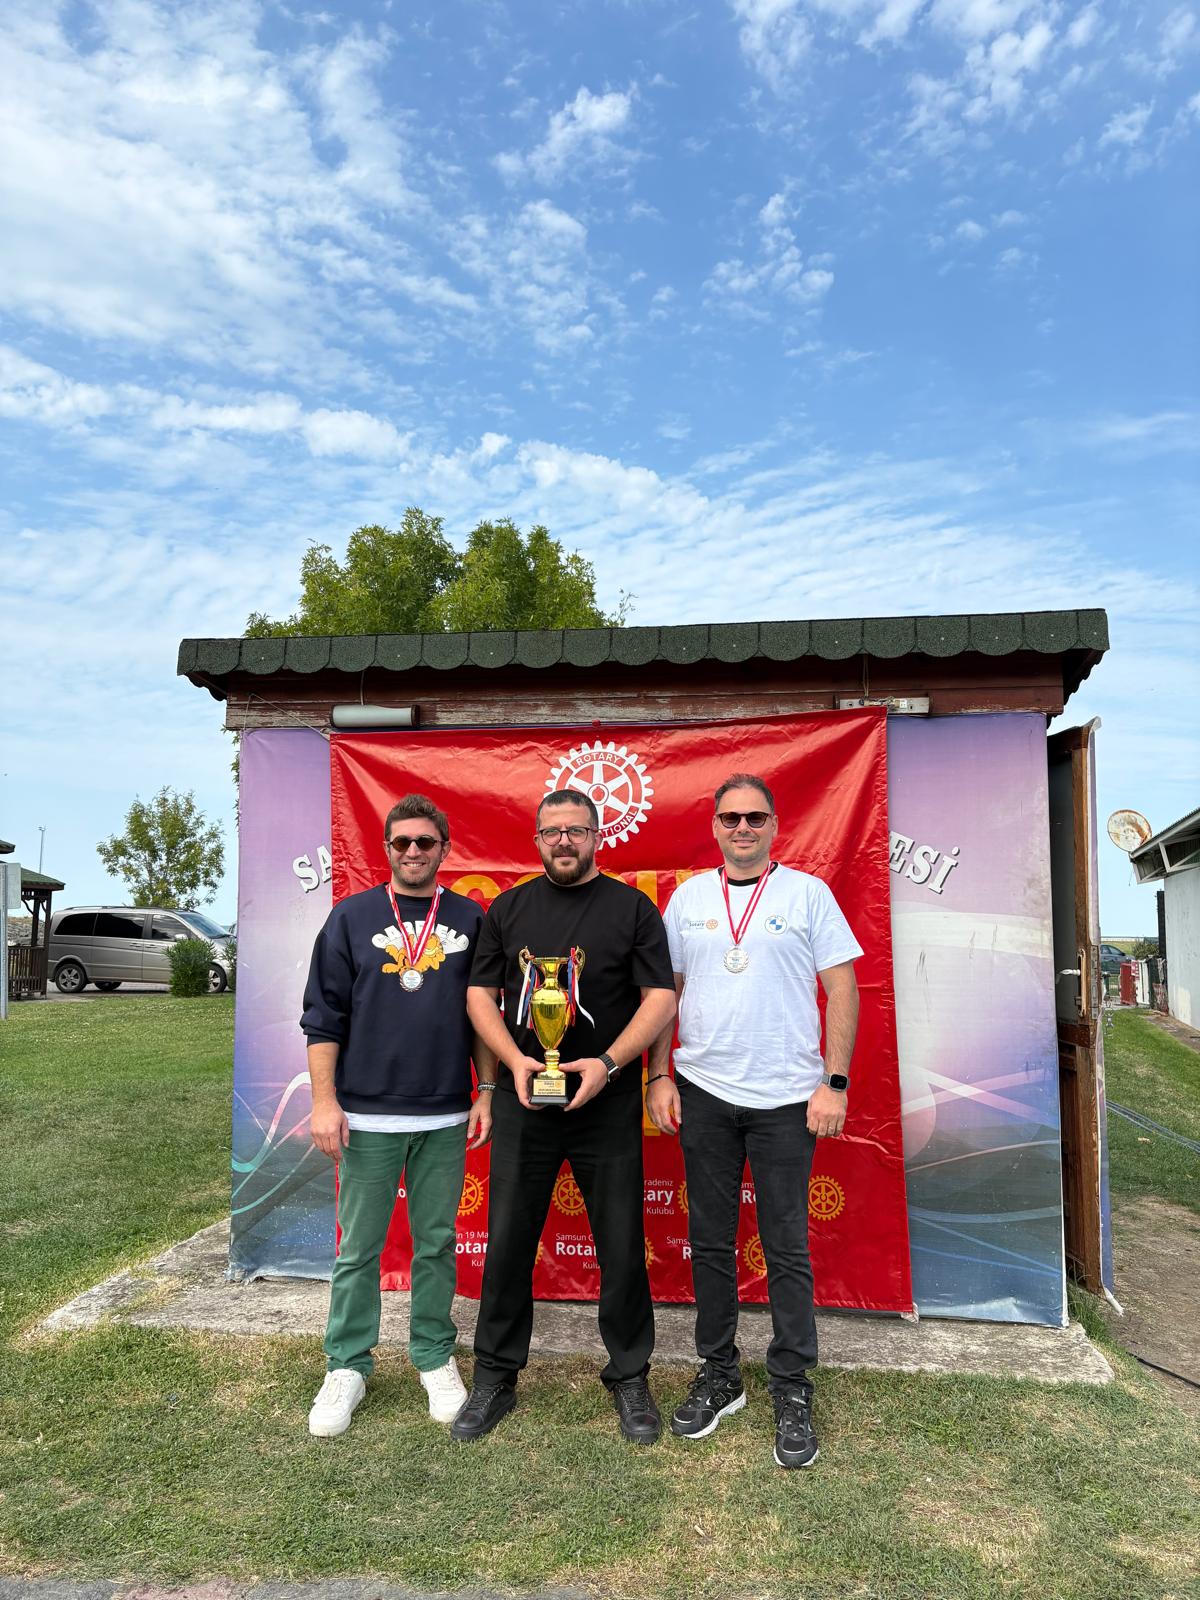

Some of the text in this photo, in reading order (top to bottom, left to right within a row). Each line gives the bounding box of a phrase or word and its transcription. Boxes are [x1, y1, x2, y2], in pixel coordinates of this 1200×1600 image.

[576, 752, 620, 766] ROTARY
[601, 810, 638, 837] TIONAL
[644, 1179, 674, 1187] radeniz
[477, 1231, 489, 1239] Ma
[555, 1232, 587, 1241] Samsun
[455, 1240, 488, 1255] otar
[471, 1259, 484, 1267] Kul
